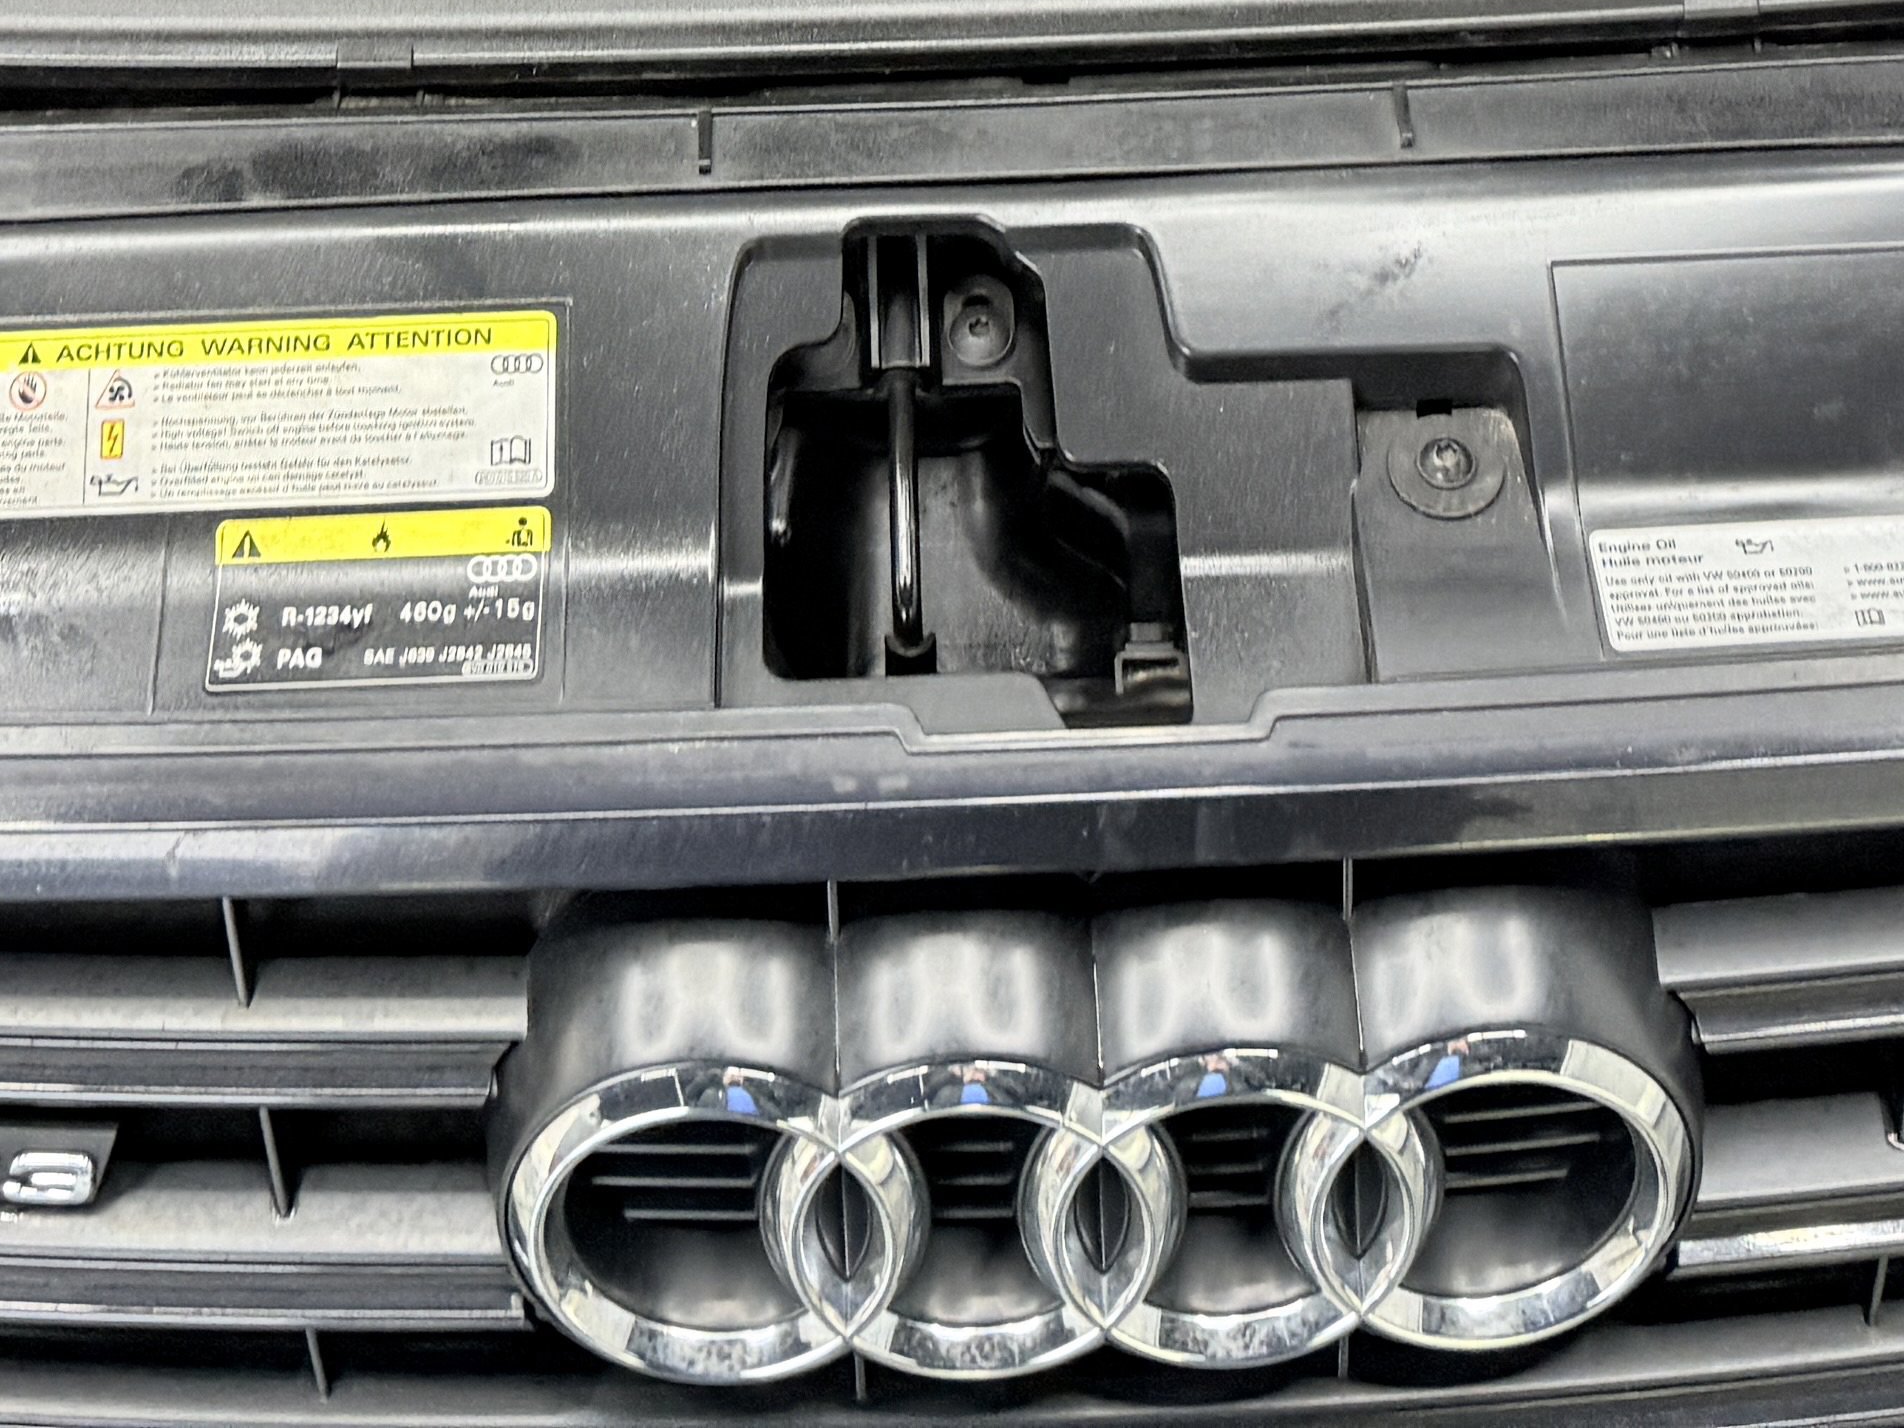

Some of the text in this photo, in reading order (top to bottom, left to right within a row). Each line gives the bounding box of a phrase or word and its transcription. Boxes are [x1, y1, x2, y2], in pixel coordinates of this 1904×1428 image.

[56, 327, 493, 364] ACHTUNG WARNING ATTENTION
[1598, 538, 1677, 555] Engine Oil
[1602, 553, 1705, 568] Huile moteur
[1676, 570, 1701, 583] with
[1703, 570, 1723, 581] VW
[468, 585, 499, 598] Audi
[281, 603, 374, 629] R-1234yf
[276, 647, 323, 670] PAG
